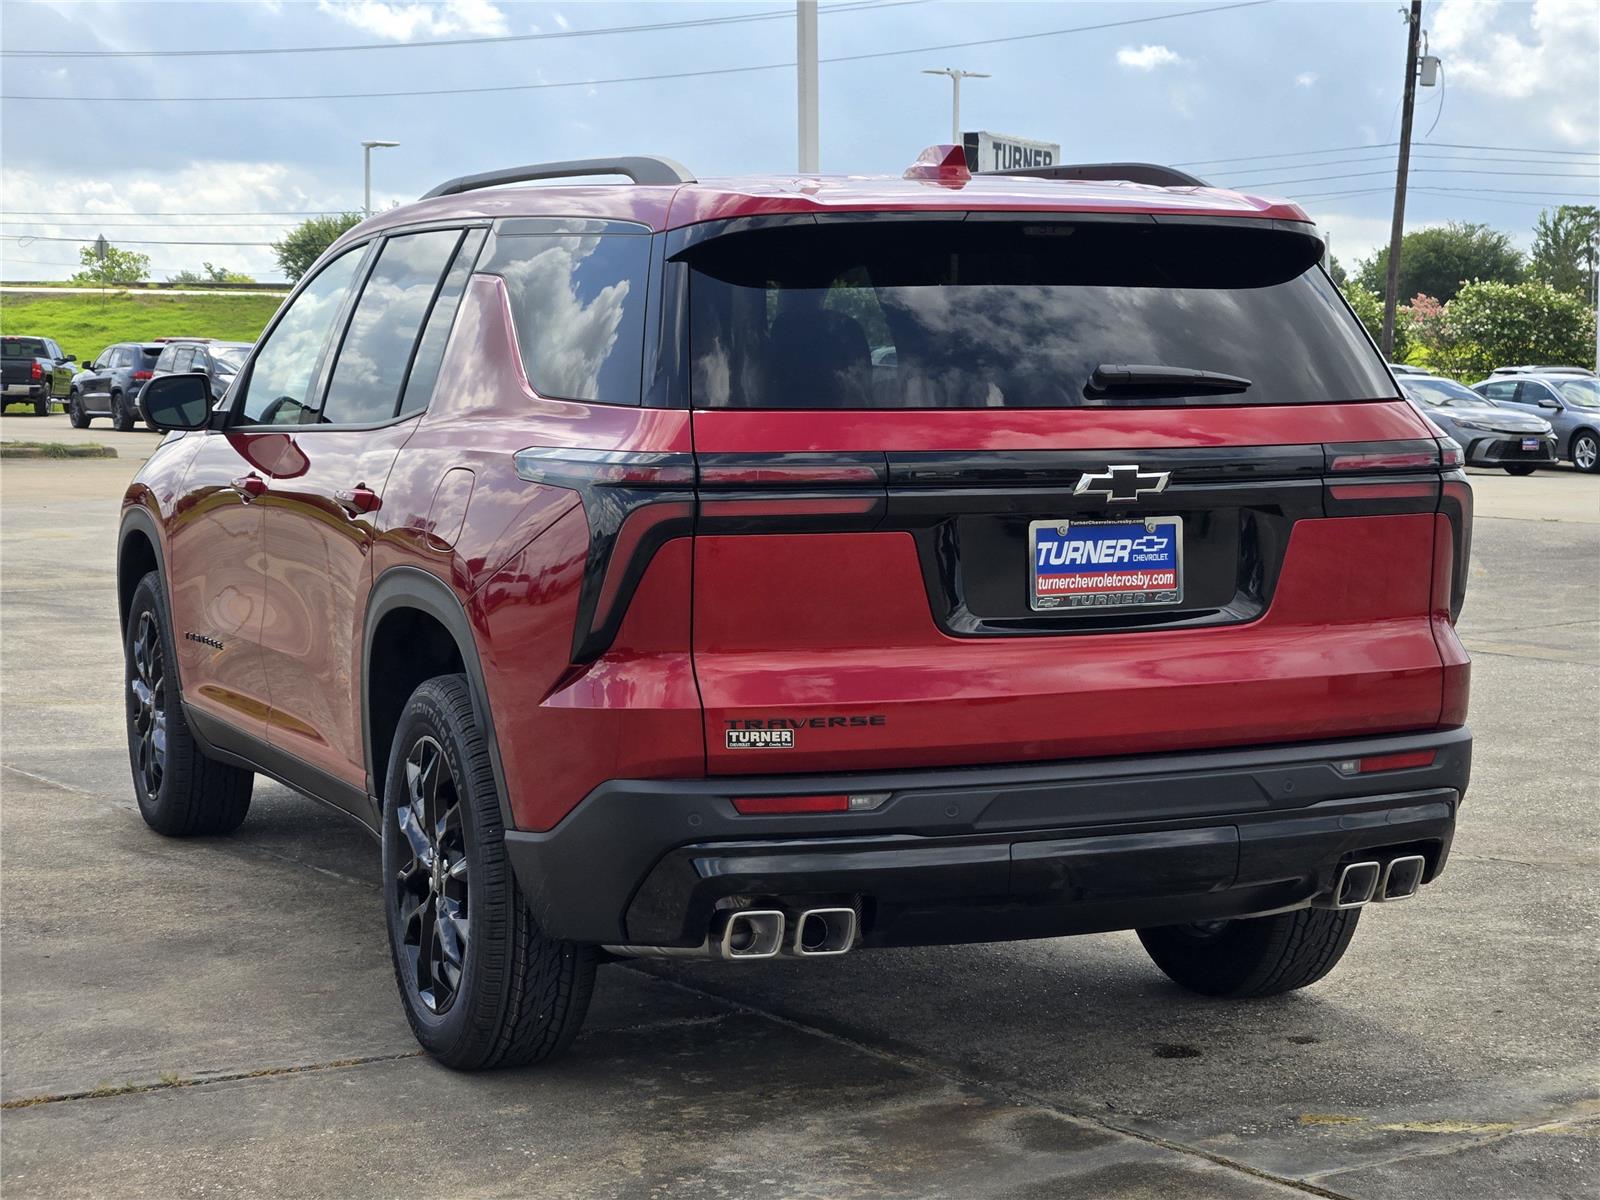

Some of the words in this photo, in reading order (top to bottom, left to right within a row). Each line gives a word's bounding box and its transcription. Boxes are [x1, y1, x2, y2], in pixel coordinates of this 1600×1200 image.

[992, 142, 1052, 170] TURNER
[1037, 539, 1133, 566] TURNER
[1132, 553, 1168, 562] CHEVROLET
[1038, 571, 1174, 590] turnerchevroletcrosby.com
[1070, 592, 1146, 606] TURNER
[725, 715, 886, 729] TRAVERSE
[729, 731, 791, 742] TURNER
